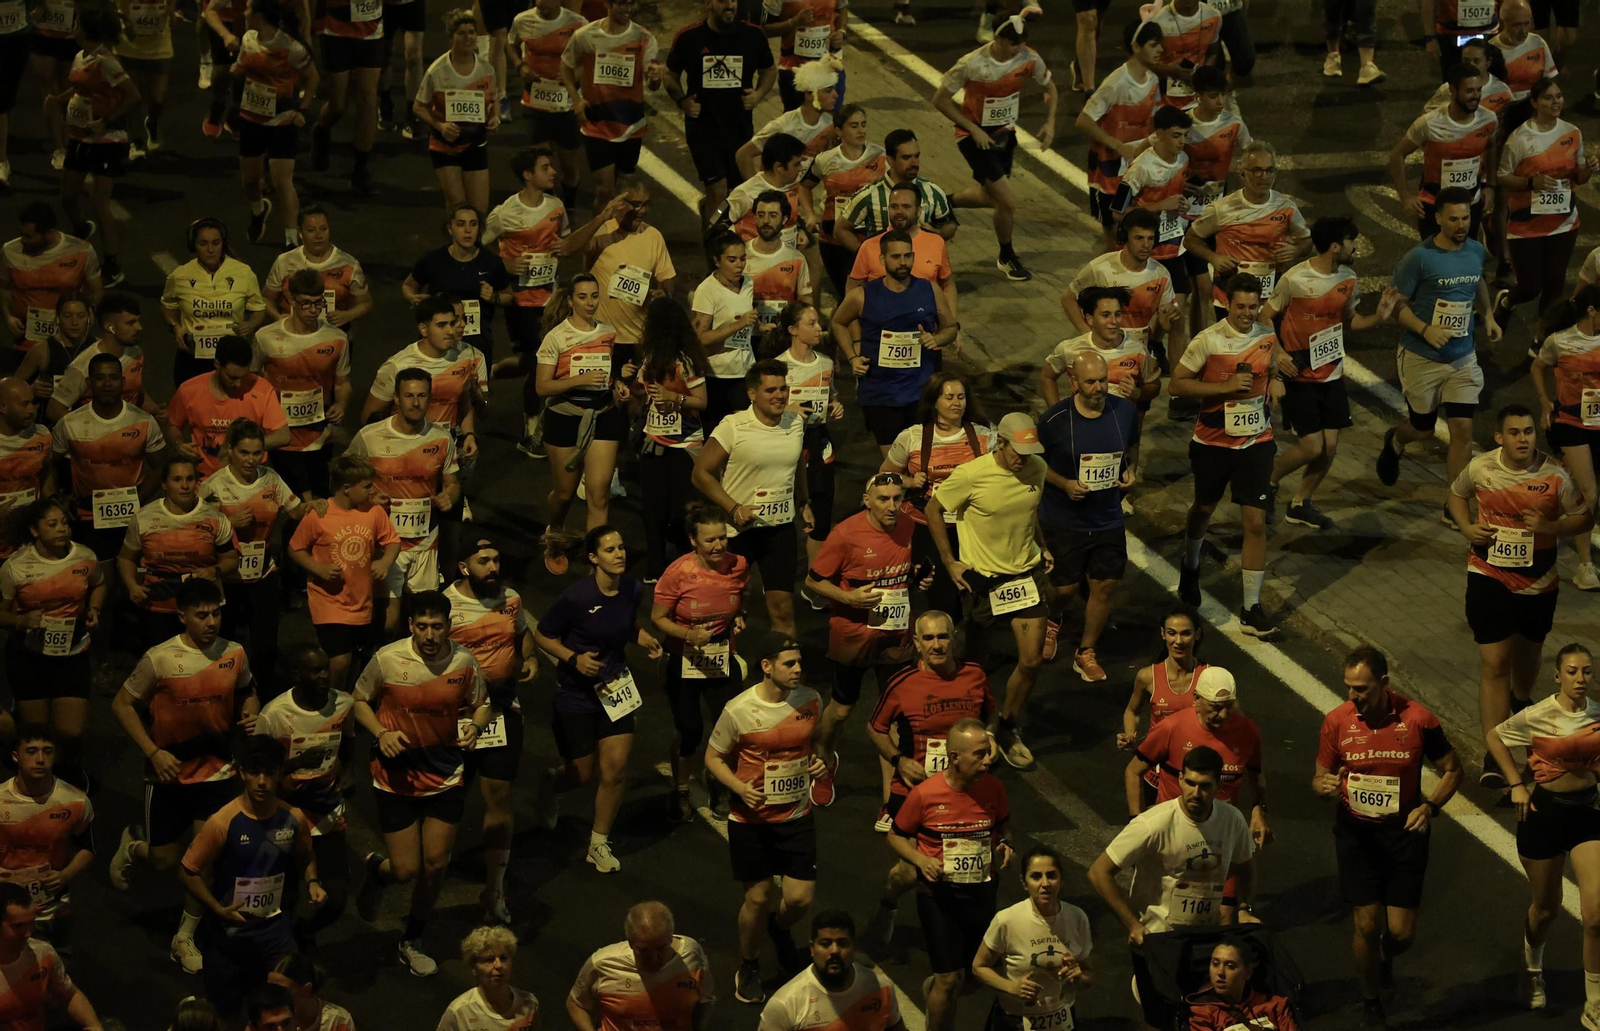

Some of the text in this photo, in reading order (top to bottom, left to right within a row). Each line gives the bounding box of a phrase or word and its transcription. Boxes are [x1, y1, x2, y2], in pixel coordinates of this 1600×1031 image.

[1463, 6, 1490, 18] 15074
[799, 38, 827, 49] 20597
[600, 65, 629, 78] 10662
[245, 90, 271, 107] 13397
[534, 89, 563, 103] 20520
[451, 102, 480, 114] 10663
[990, 107, 1012, 118] 8601
[1449, 171, 1472, 183] 3287
[1539, 193, 1564, 205] 3286
[616, 276, 641, 293] 7609
[1437, 275, 1480, 287] SYNERGYM
[193, 299, 233, 309] Khalifa
[193, 309, 233, 319] Capital
[1438, 314, 1466, 327] 10291
[35, 321, 60, 335] 3567
[317, 347, 334, 355] KH7
[888, 346, 913, 358] 7501
[1313, 339, 1339, 358] 15638
[1119, 360, 1136, 369] KH7
[286, 401, 319, 416] 13027
[1233, 412, 1259, 426] 2169
[122, 429, 140, 438] KH7
[423, 446, 439, 455] KH7
[1085, 466, 1115, 481] 11451
[1528, 483, 1547, 493] KH7
[99, 502, 135, 517] 16362
[760, 501, 789, 516] 21518
[395, 514, 426, 526] 17114
[1492, 543, 1527, 557] 14618
[73, 567, 88, 575] KH7
[999, 586, 1028, 602] 4561
[875, 605, 906, 619] 18207
[219, 659, 234, 669] KH7
[689, 655, 724, 668] 12145
[448, 675, 464, 686] KH7
[608, 687, 632, 707] 3419
[923, 702, 944, 715] LOS
[1345, 749, 1410, 761] Los Lentos
[770, 775, 805, 792] 10996
[1352, 790, 1392, 807] 16697
[50, 809, 70, 821] KH7
[953, 856, 984, 871] 3670
[244, 893, 274, 908] 1500
[1181, 899, 1212, 914] 1104
[1030, 1008, 1067, 1031] 22739
